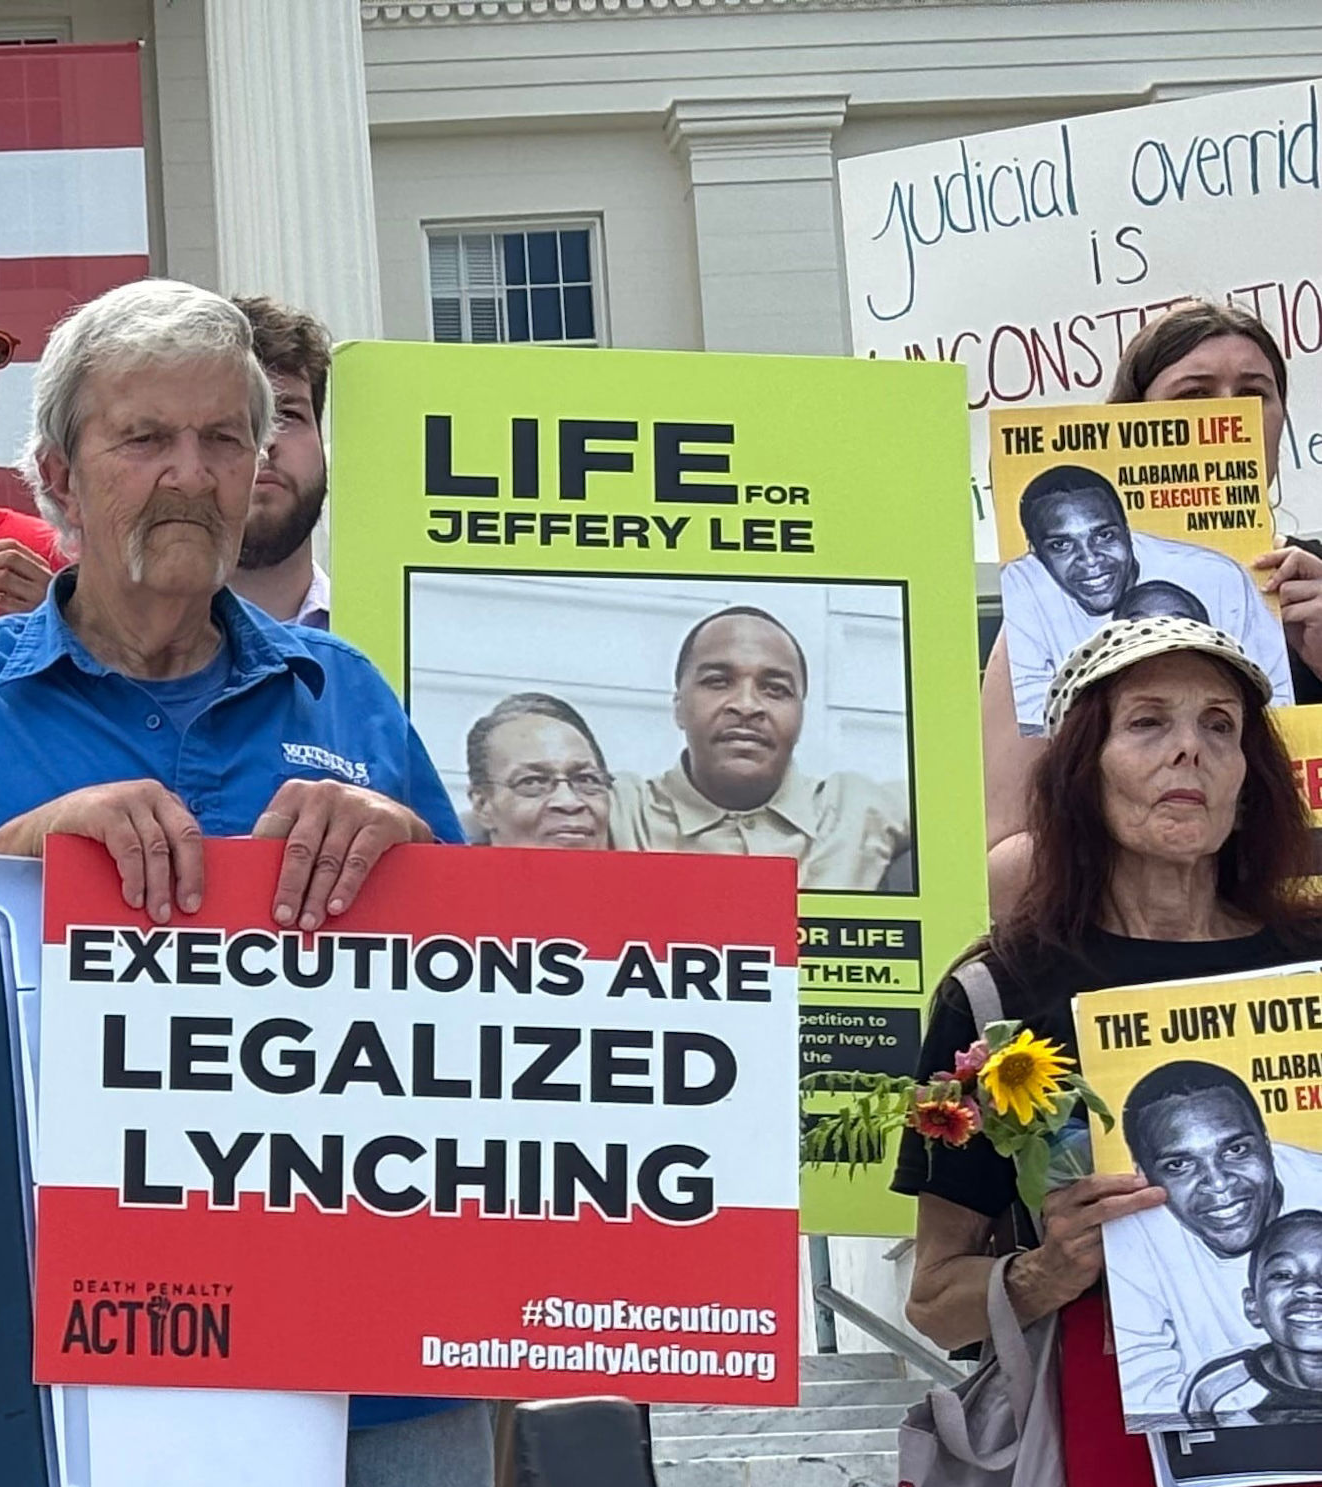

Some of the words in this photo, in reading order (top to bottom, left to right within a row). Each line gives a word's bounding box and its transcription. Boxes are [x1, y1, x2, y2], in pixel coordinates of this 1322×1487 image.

[867, 124, 1078, 320] judicial
[1090, 225, 1148, 285] is
[1002, 427, 1044, 454] THE
[1052, 424, 1108, 451] JURY
[1118, 420, 1190, 448] VOTED
[1198, 417, 1251, 446] LIFE.
[425, 414, 738, 504] LIFE
[745, 485, 810, 505] FOR
[1118, 465, 1200, 485] ALABAMA
[1205, 461, 1258, 482] PLANS
[1126, 492, 1145, 510] TO
[1150, 487, 1221, 508] EXECUTE
[1226, 485, 1259, 504] HIM
[427, 510, 691, 549] JEFFERY
[709, 517, 814, 553] LEE
[1187, 510, 1263, 531] ANYWAY.
[840, 928, 905, 947] LIFE
[68, 929, 584, 998] EXECUTIONS
[607, 944, 772, 1003] ARE
[801, 964, 900, 984] THEM.
[868, 1016, 887, 1027] to
[1094, 1013, 1152, 1051] THE
[1160, 1003, 1238, 1045] JURY
[803, 1051, 832, 1063] the
[839, 1033, 875, 1048] Ivey
[878, 1034, 897, 1046] to
[102, 1014, 737, 1107] LEGALIZED
[1260, 1088, 1288, 1114] TO
[122, 1128, 715, 1224] LYNCHING
[73, 1279, 135, 1294] DEATH
[146, 1281, 234, 1298] PENALTY
[521, 1298, 776, 1337] #StopExecutions
[421, 1336, 776, 1382] DeathPenaltyAction.org
